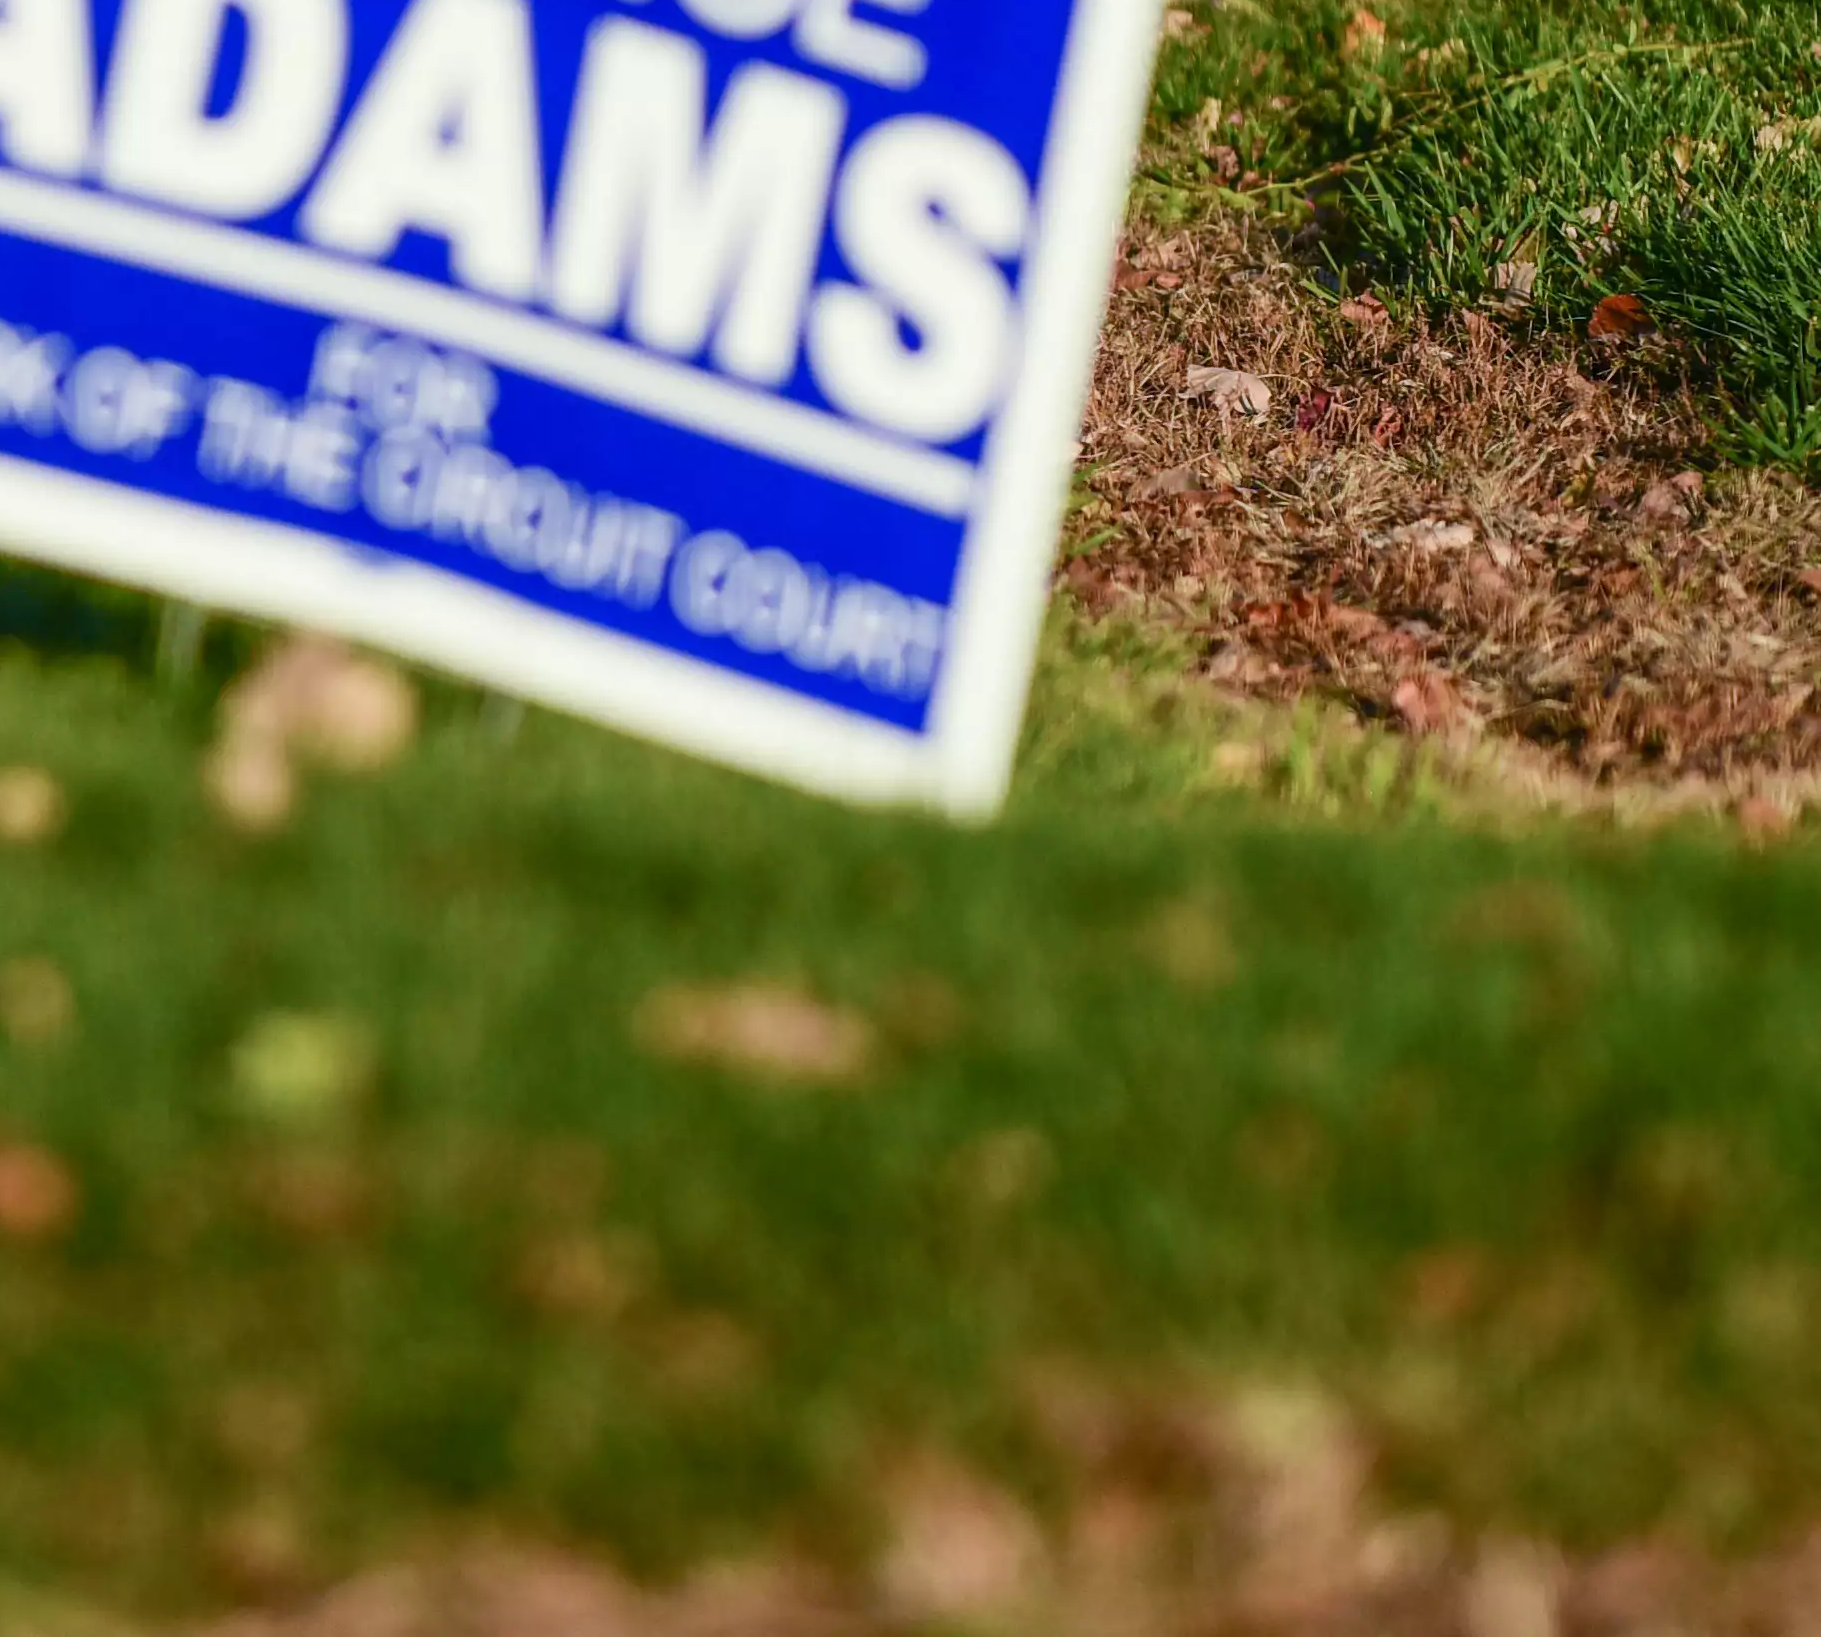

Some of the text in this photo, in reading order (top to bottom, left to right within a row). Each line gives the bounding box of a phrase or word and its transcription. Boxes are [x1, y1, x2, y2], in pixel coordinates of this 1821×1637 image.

[62, 345, 200, 460] OF
[197, 374, 365, 513] THE
[360, 422, 690, 609] CIRCUIT
[670, 528, 953, 700] COURT
